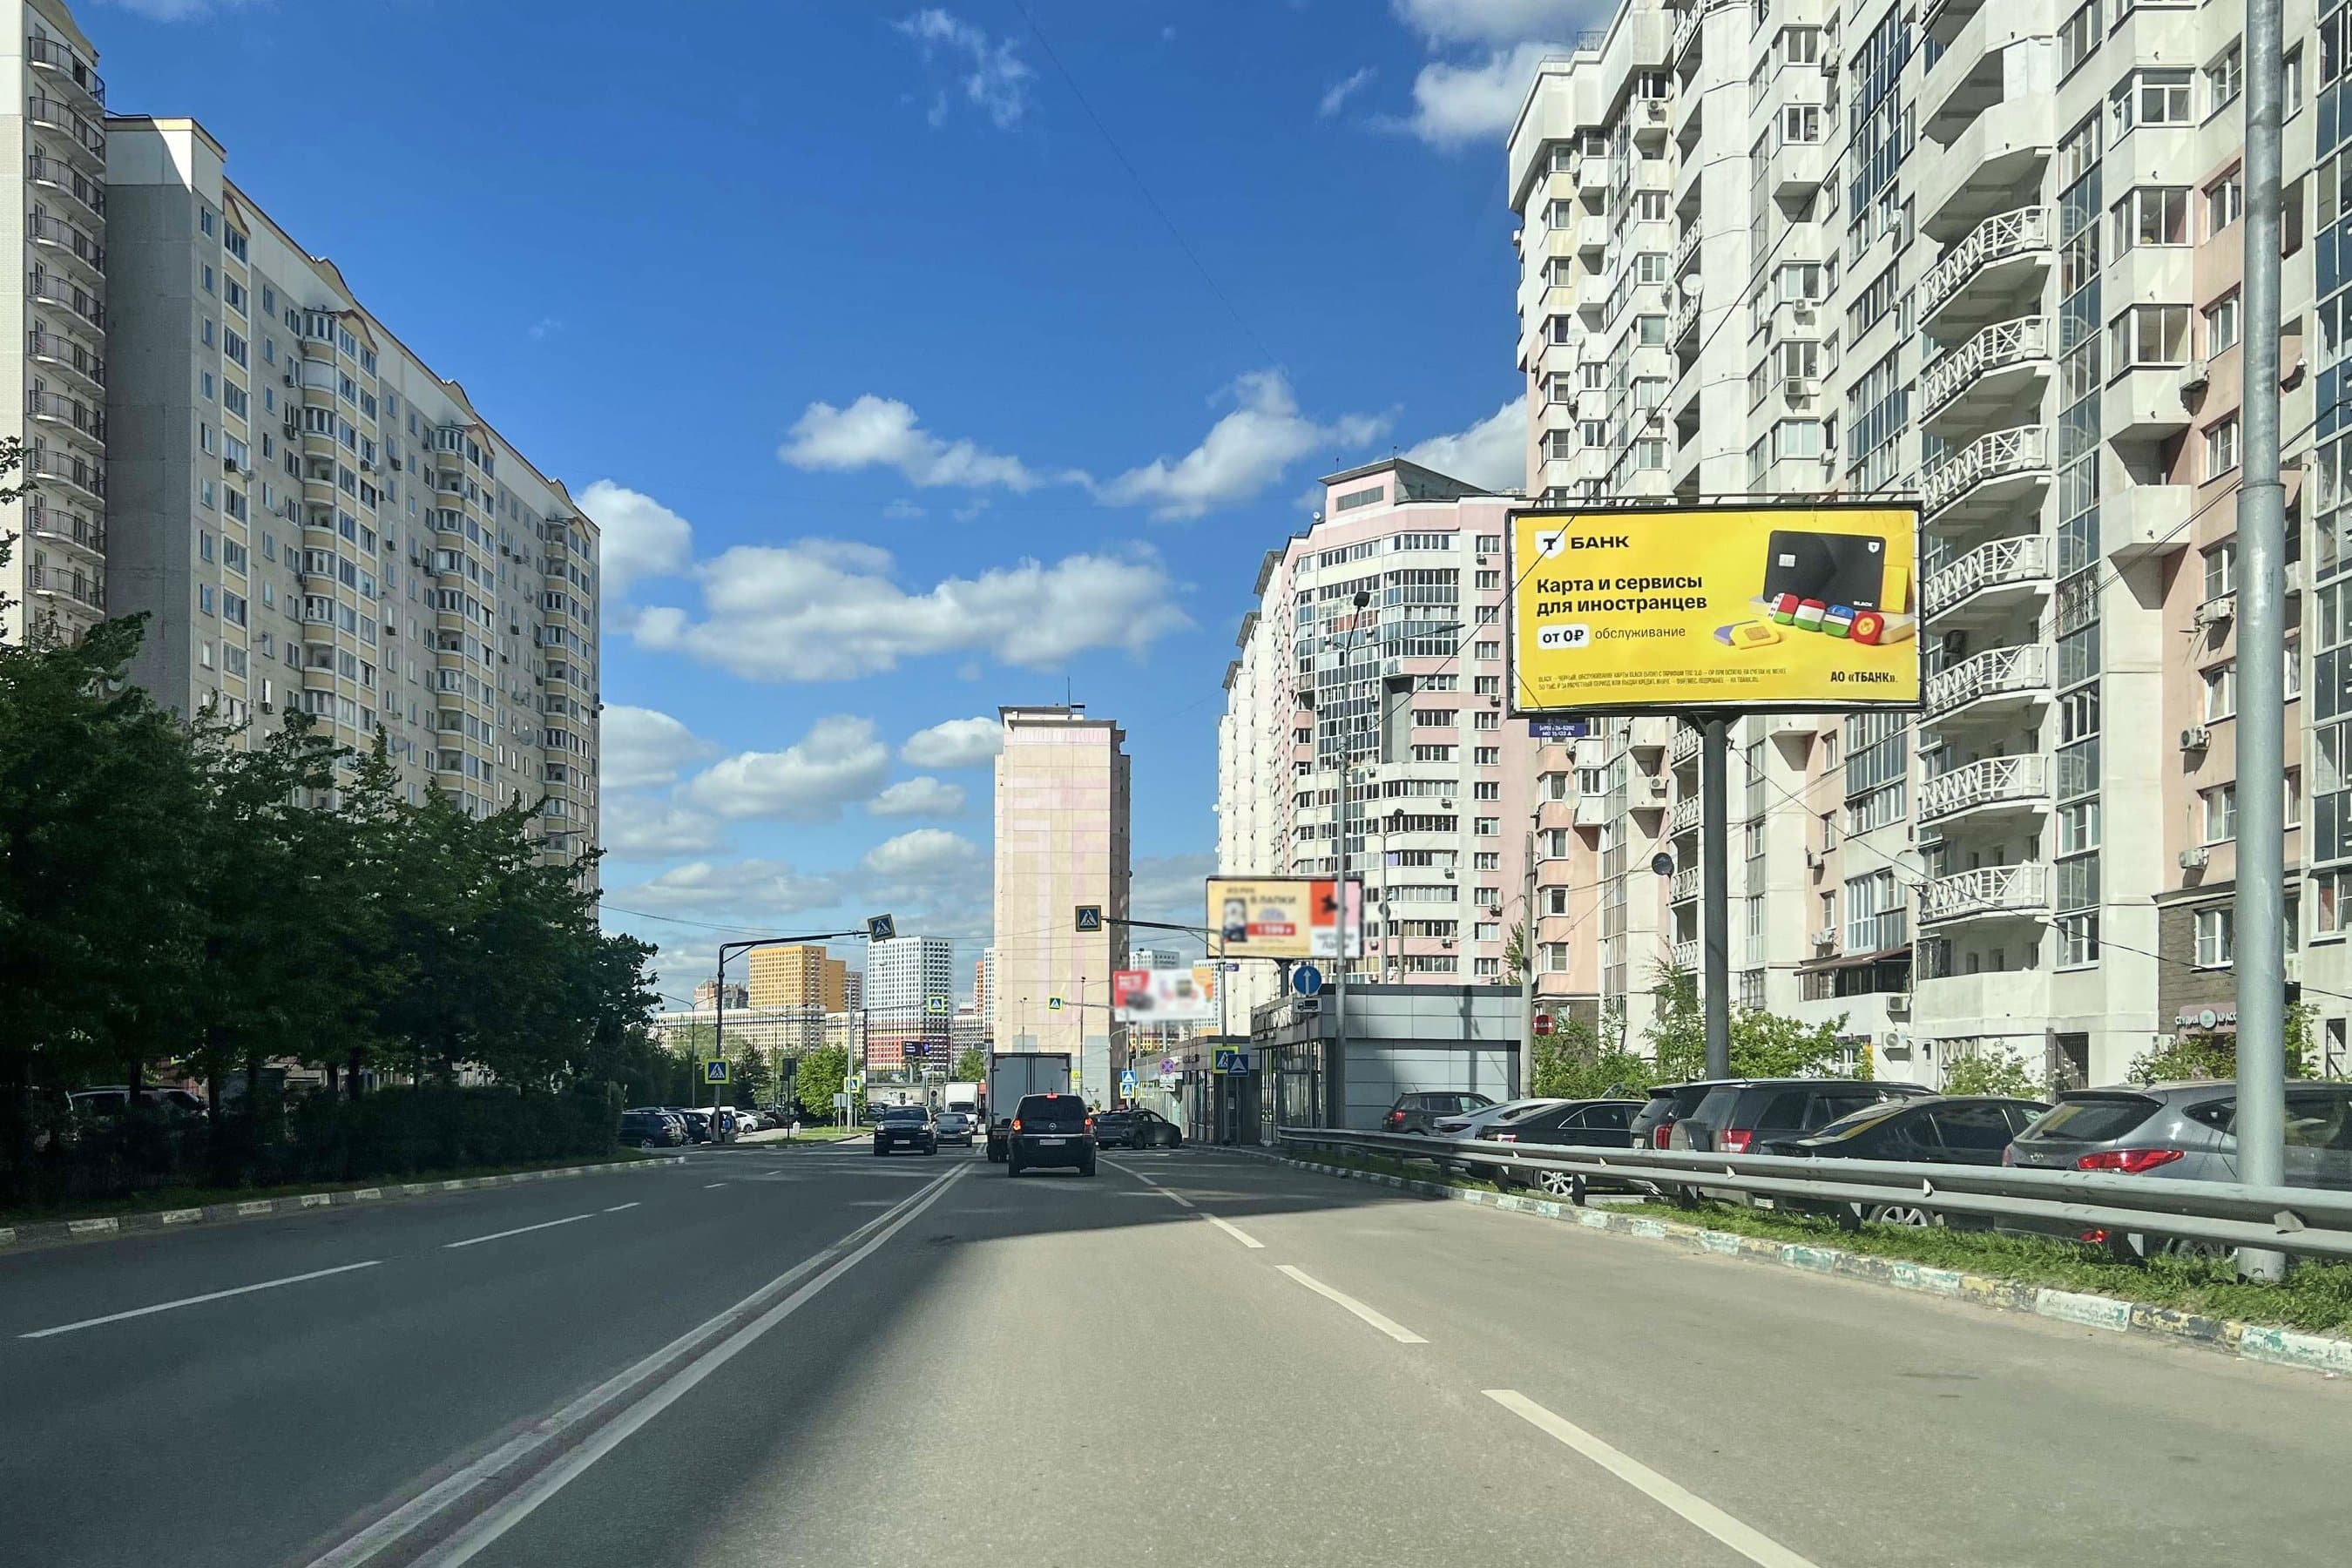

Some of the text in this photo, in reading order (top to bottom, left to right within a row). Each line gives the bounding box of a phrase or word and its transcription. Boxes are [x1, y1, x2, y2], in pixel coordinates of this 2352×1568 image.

[1571, 536, 1631, 549] БАНК
[1537, 576, 1702, 595] Карта и сервисы
[1537, 597, 1707, 617] для иностранцев
[1543, 632, 1560, 644] от
[1595, 627, 1686, 641] обслуживание
[1830, 671, 1845, 682] АО
